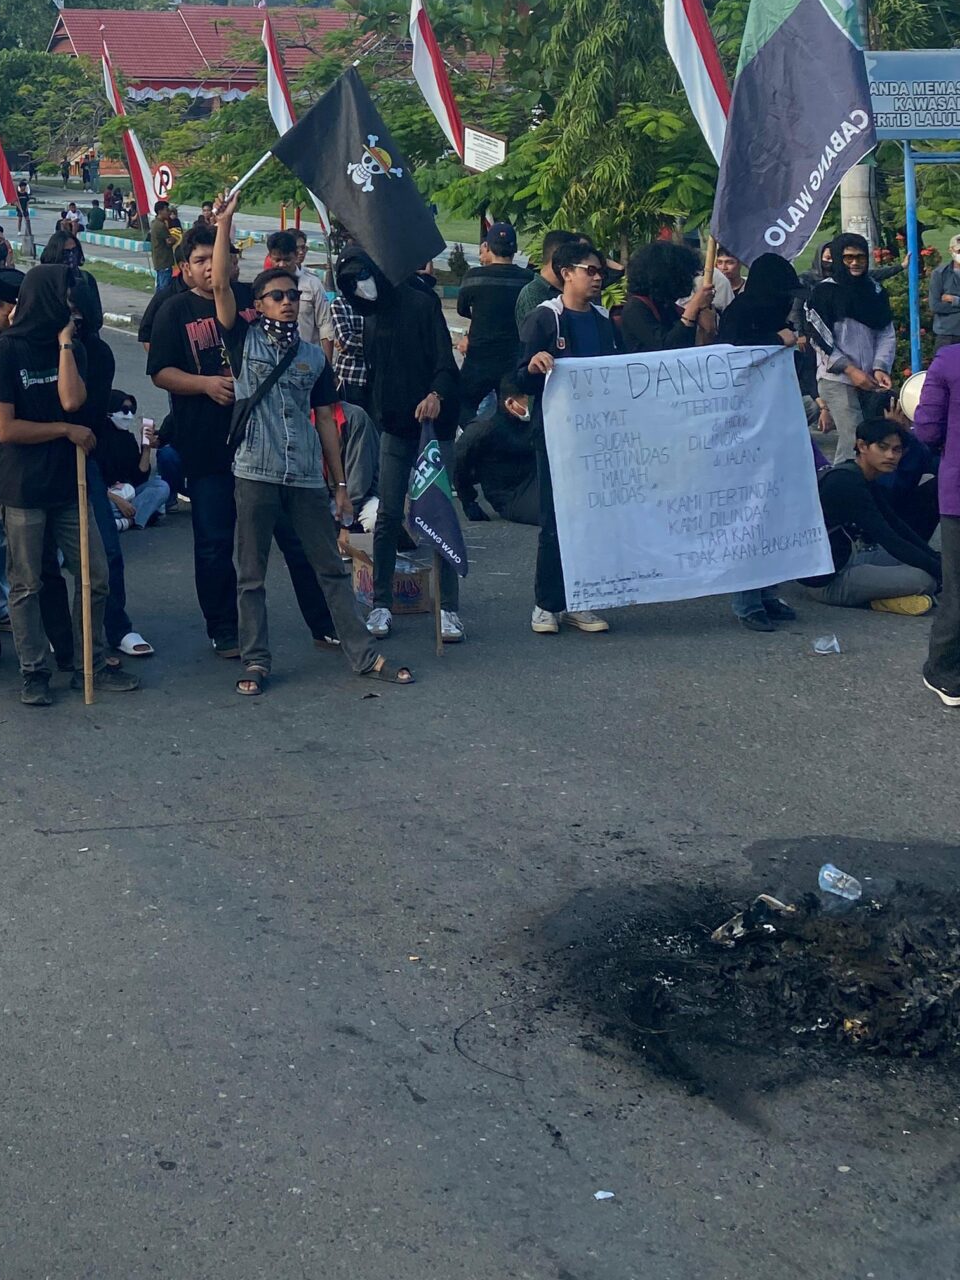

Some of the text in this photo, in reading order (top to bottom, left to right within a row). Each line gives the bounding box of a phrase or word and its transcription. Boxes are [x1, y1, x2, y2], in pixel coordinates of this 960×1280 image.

[869, 81, 910, 96] ANDA
[625, 348, 769, 400] DANGER
[594, 431, 641, 452] SUDAH
[579, 446, 671, 471] TERTINDAS
[602, 466, 649, 489] MALAH
[667, 504, 770, 536] KAMI DILINDAS
[415, 516, 462, 564] CABANG WAJO
[732, 523, 766, 542] KAMI
